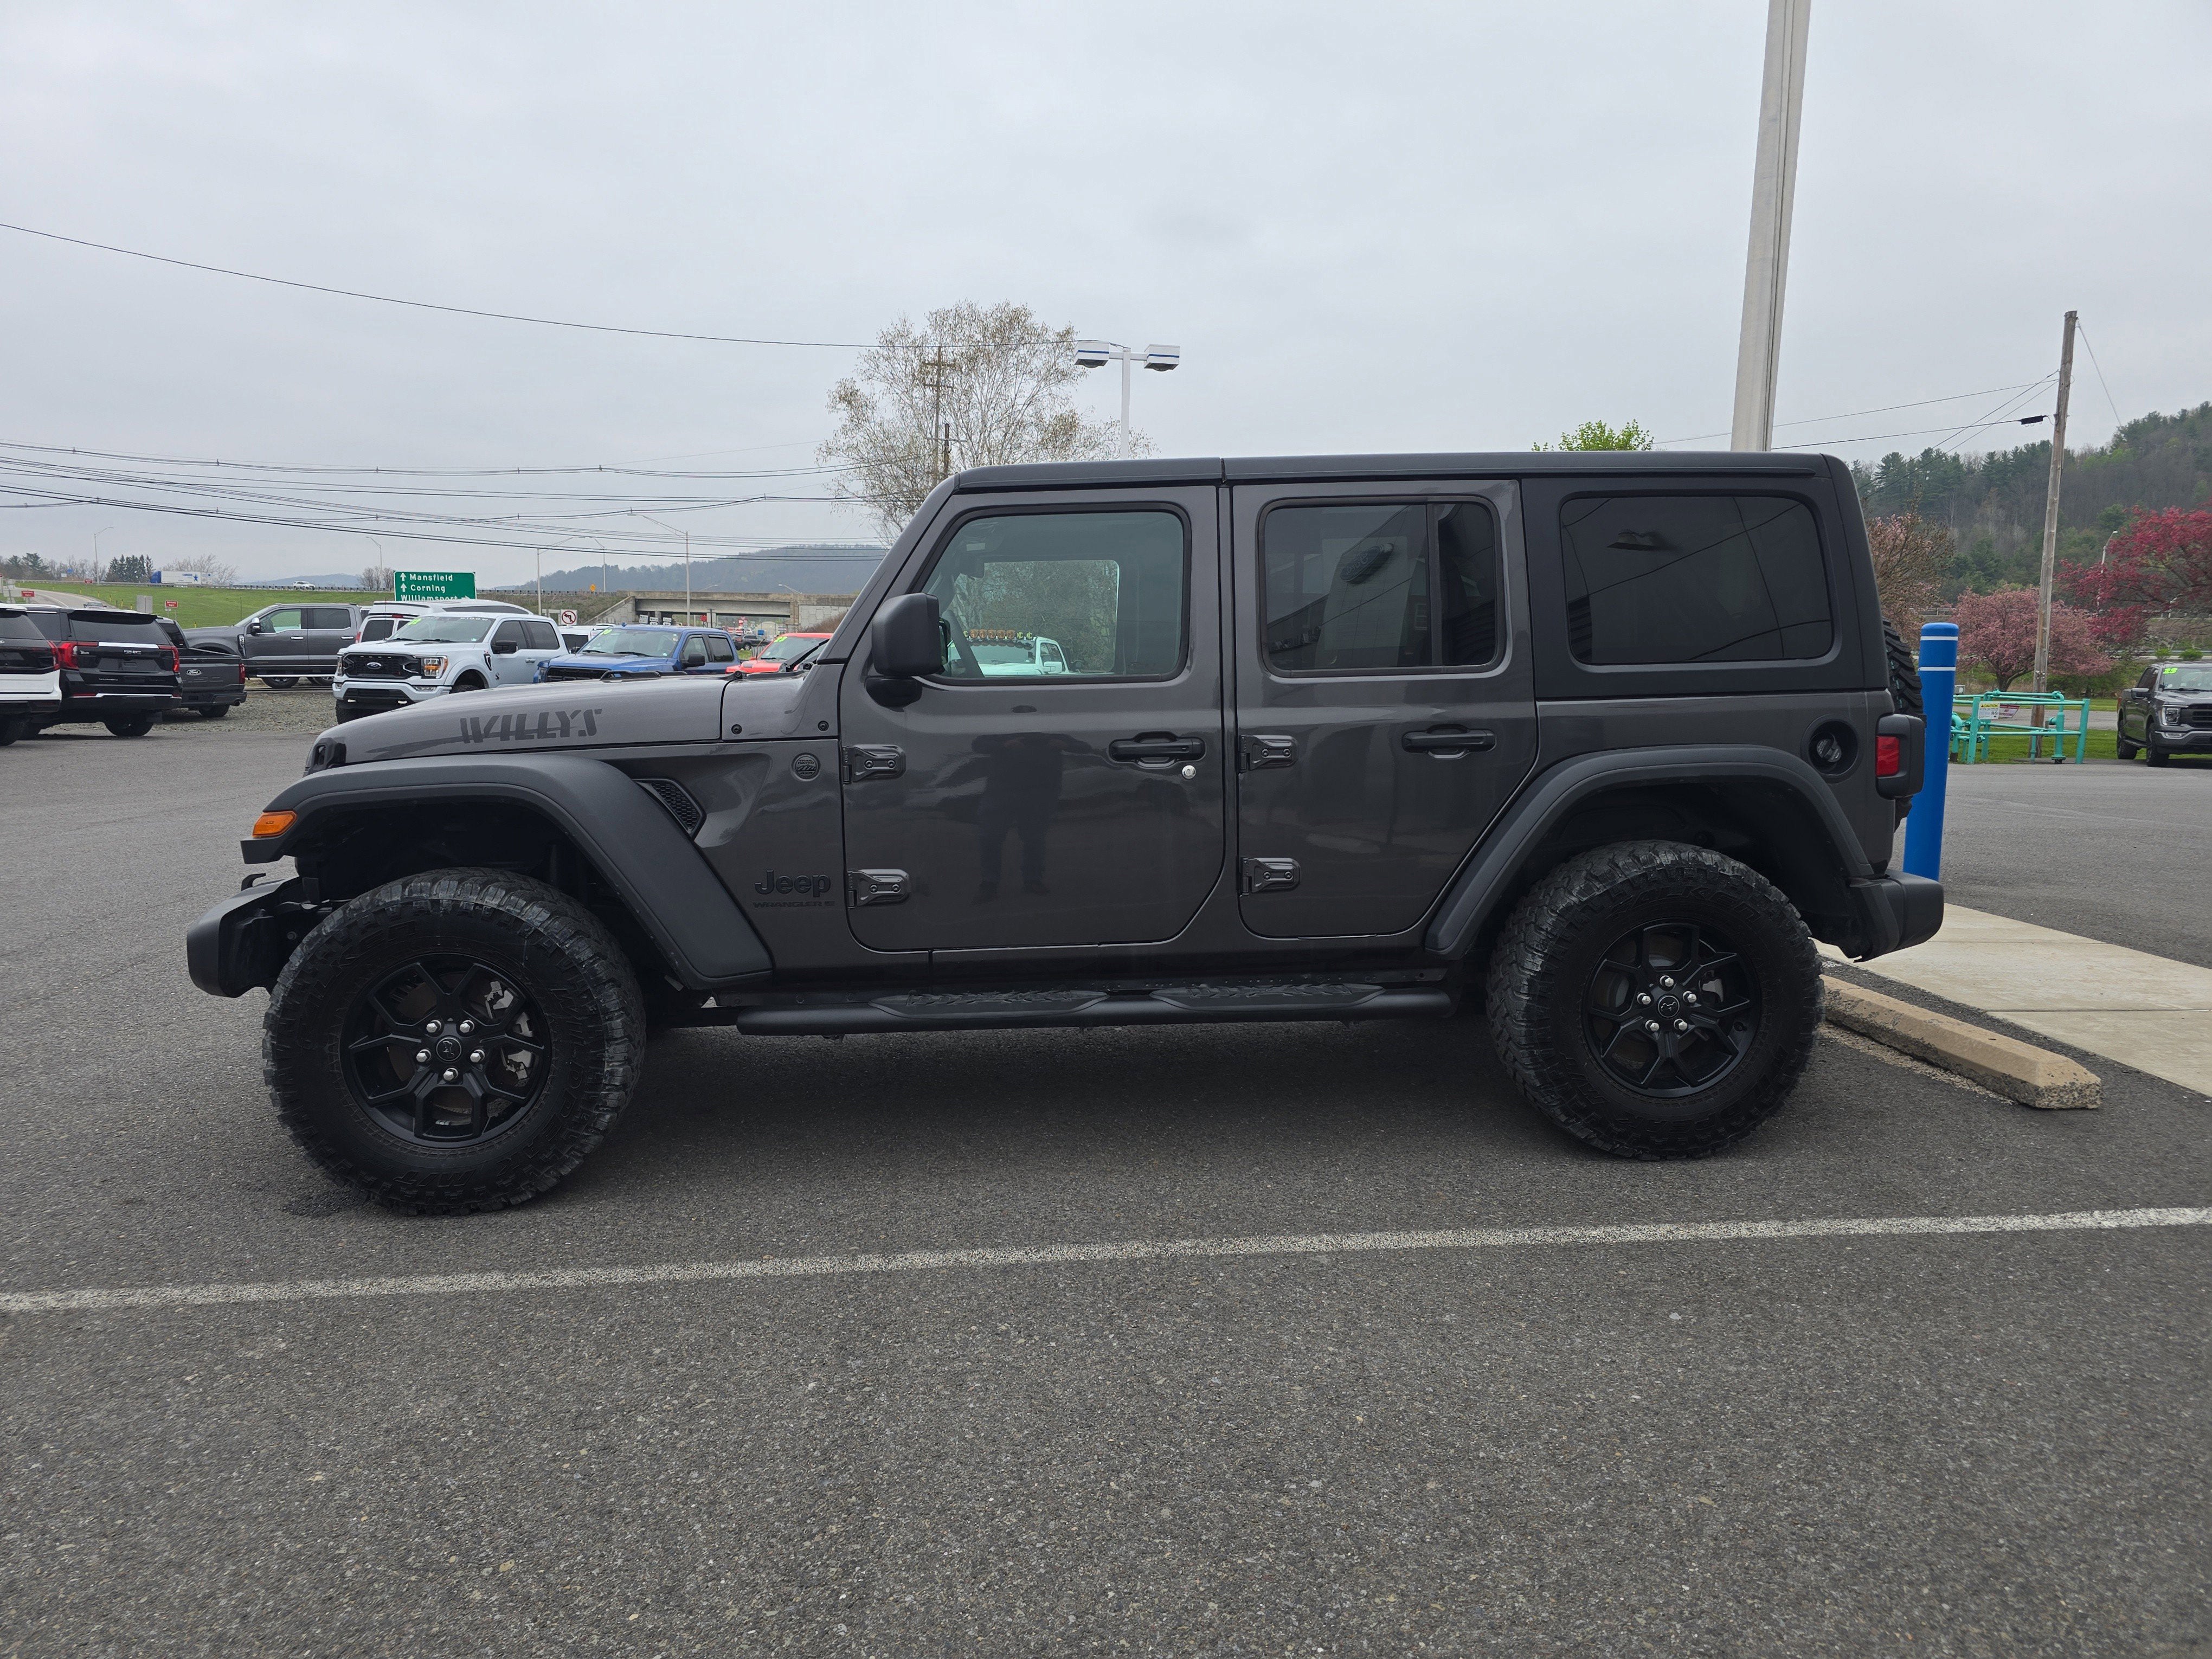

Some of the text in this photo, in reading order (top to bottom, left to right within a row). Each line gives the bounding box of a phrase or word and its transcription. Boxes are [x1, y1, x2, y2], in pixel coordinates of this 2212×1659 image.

[410, 584, 446, 593] Corning
[1017, 631, 1024, 639] KC
[460, 709, 602, 744] WILLYS
[754, 870, 831, 898] Jeep
[752, 900, 823, 908] WRANGLER
